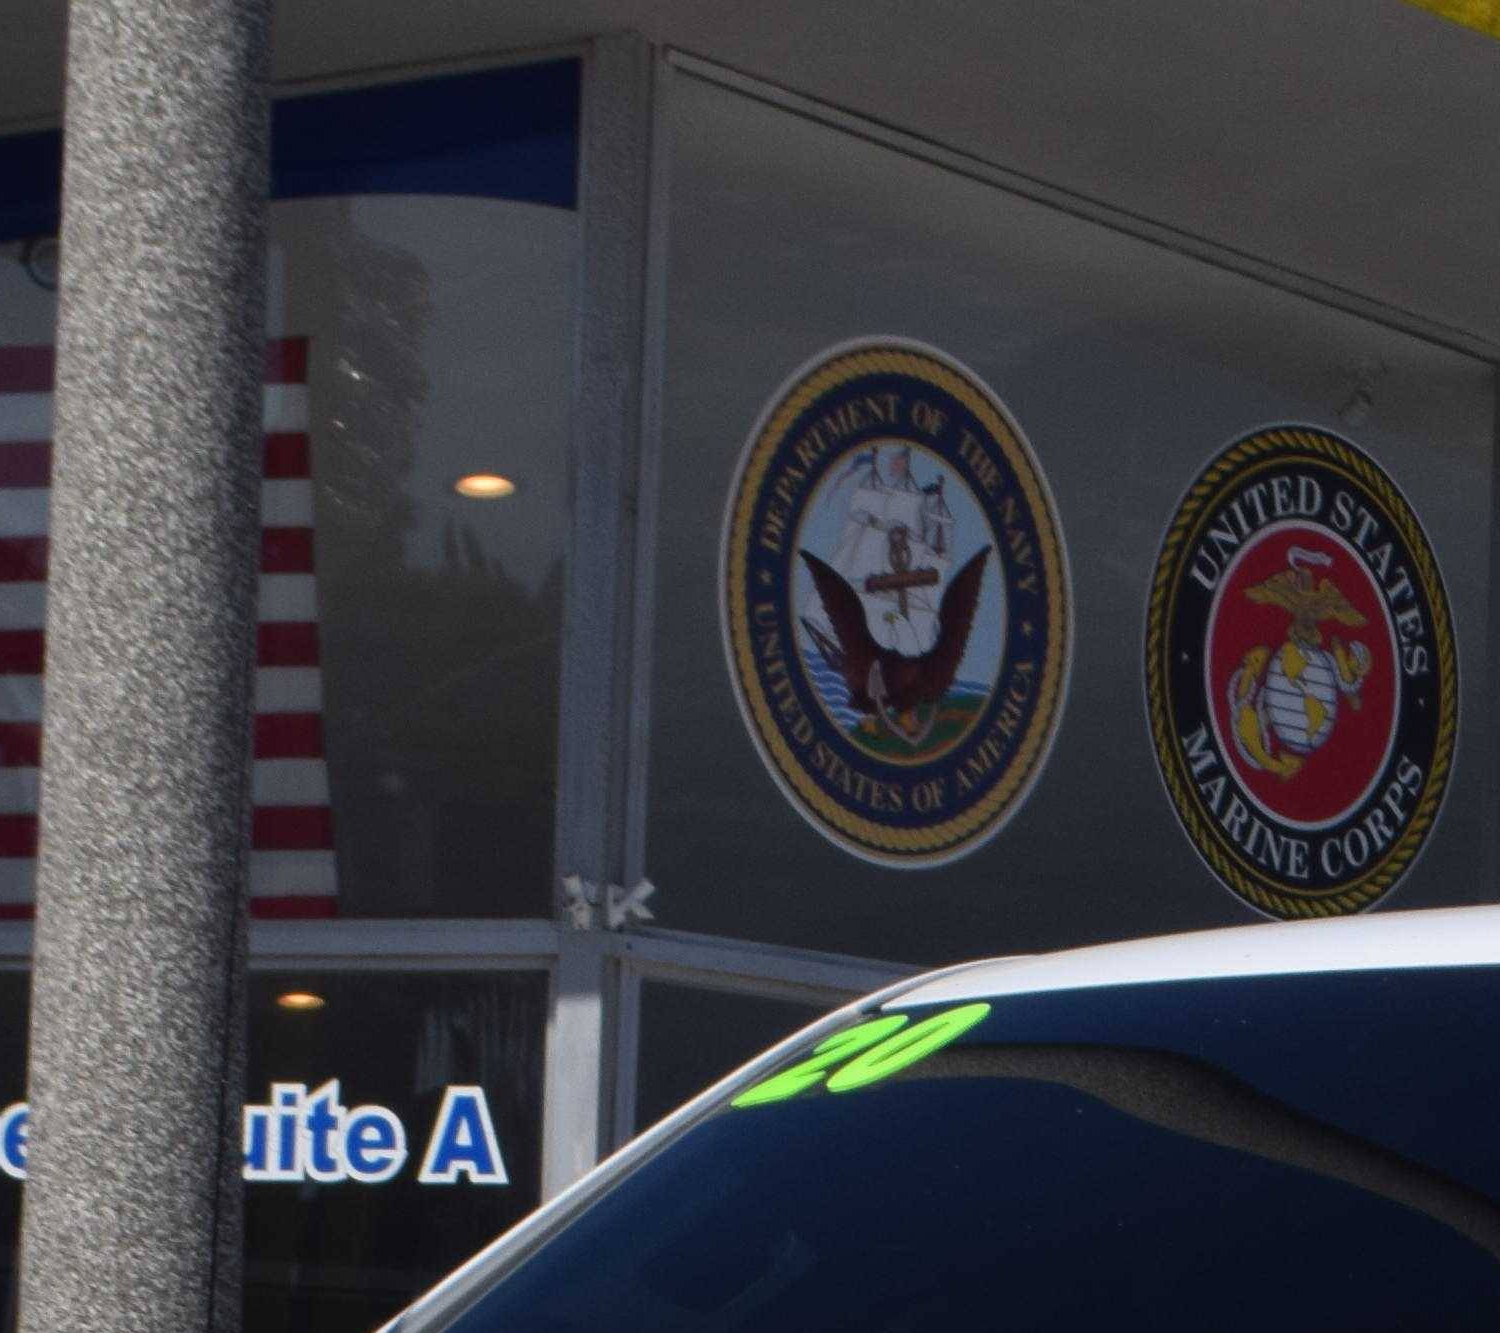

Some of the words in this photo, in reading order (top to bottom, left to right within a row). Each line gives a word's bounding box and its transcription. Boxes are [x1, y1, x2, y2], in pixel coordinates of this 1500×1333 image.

[762, 392, 899, 552] DEPARTMENT
[912, 402, 949, 435] OF
[960, 427, 999, 495] THE
[1001, 497, 1039, 594] NAVY
[1190, 475, 1324, 592] UNITED
[1330, 490, 1429, 677] STATES
[754, 603, 815, 746] UNITED
[811, 740, 904, 812] STATES
[912, 777, 946, 813] OF
[957, 661, 1035, 797] AMERICA
[1182, 721, 1310, 880] MARINE
[1320, 754, 1423, 879] CORPS
[243, 1078, 406, 1182] uite
[419, 1086, 507, 1183] A
[729, 1002, 992, 1110] 20
